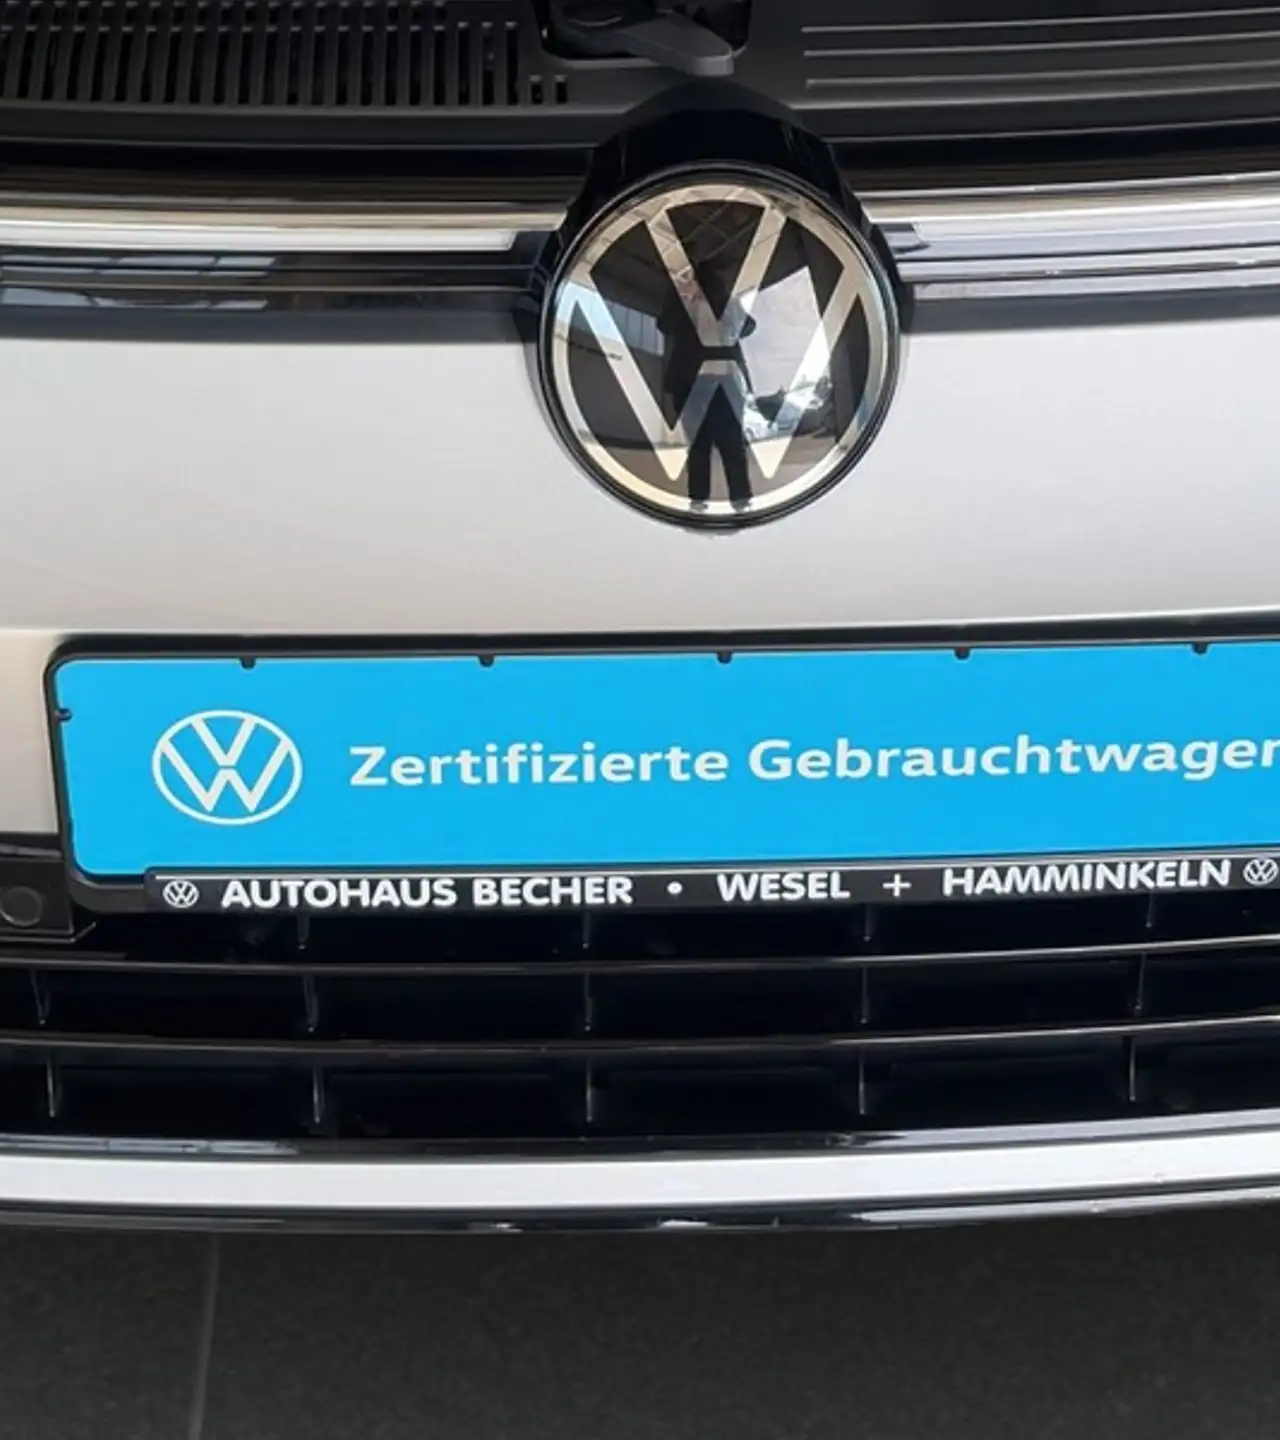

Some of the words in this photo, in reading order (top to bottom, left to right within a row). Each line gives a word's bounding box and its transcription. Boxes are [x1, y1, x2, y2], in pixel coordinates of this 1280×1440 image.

[152, 709, 303, 826] VW
[348, 741, 729, 787] Zertifizierte
[220, 876, 458, 908] AUTOHAUS
[472, 875, 634, 905] BECHER
[716, 871, 851, 901] WESEL
[942, 858, 1232, 896] HAMMINKELN
